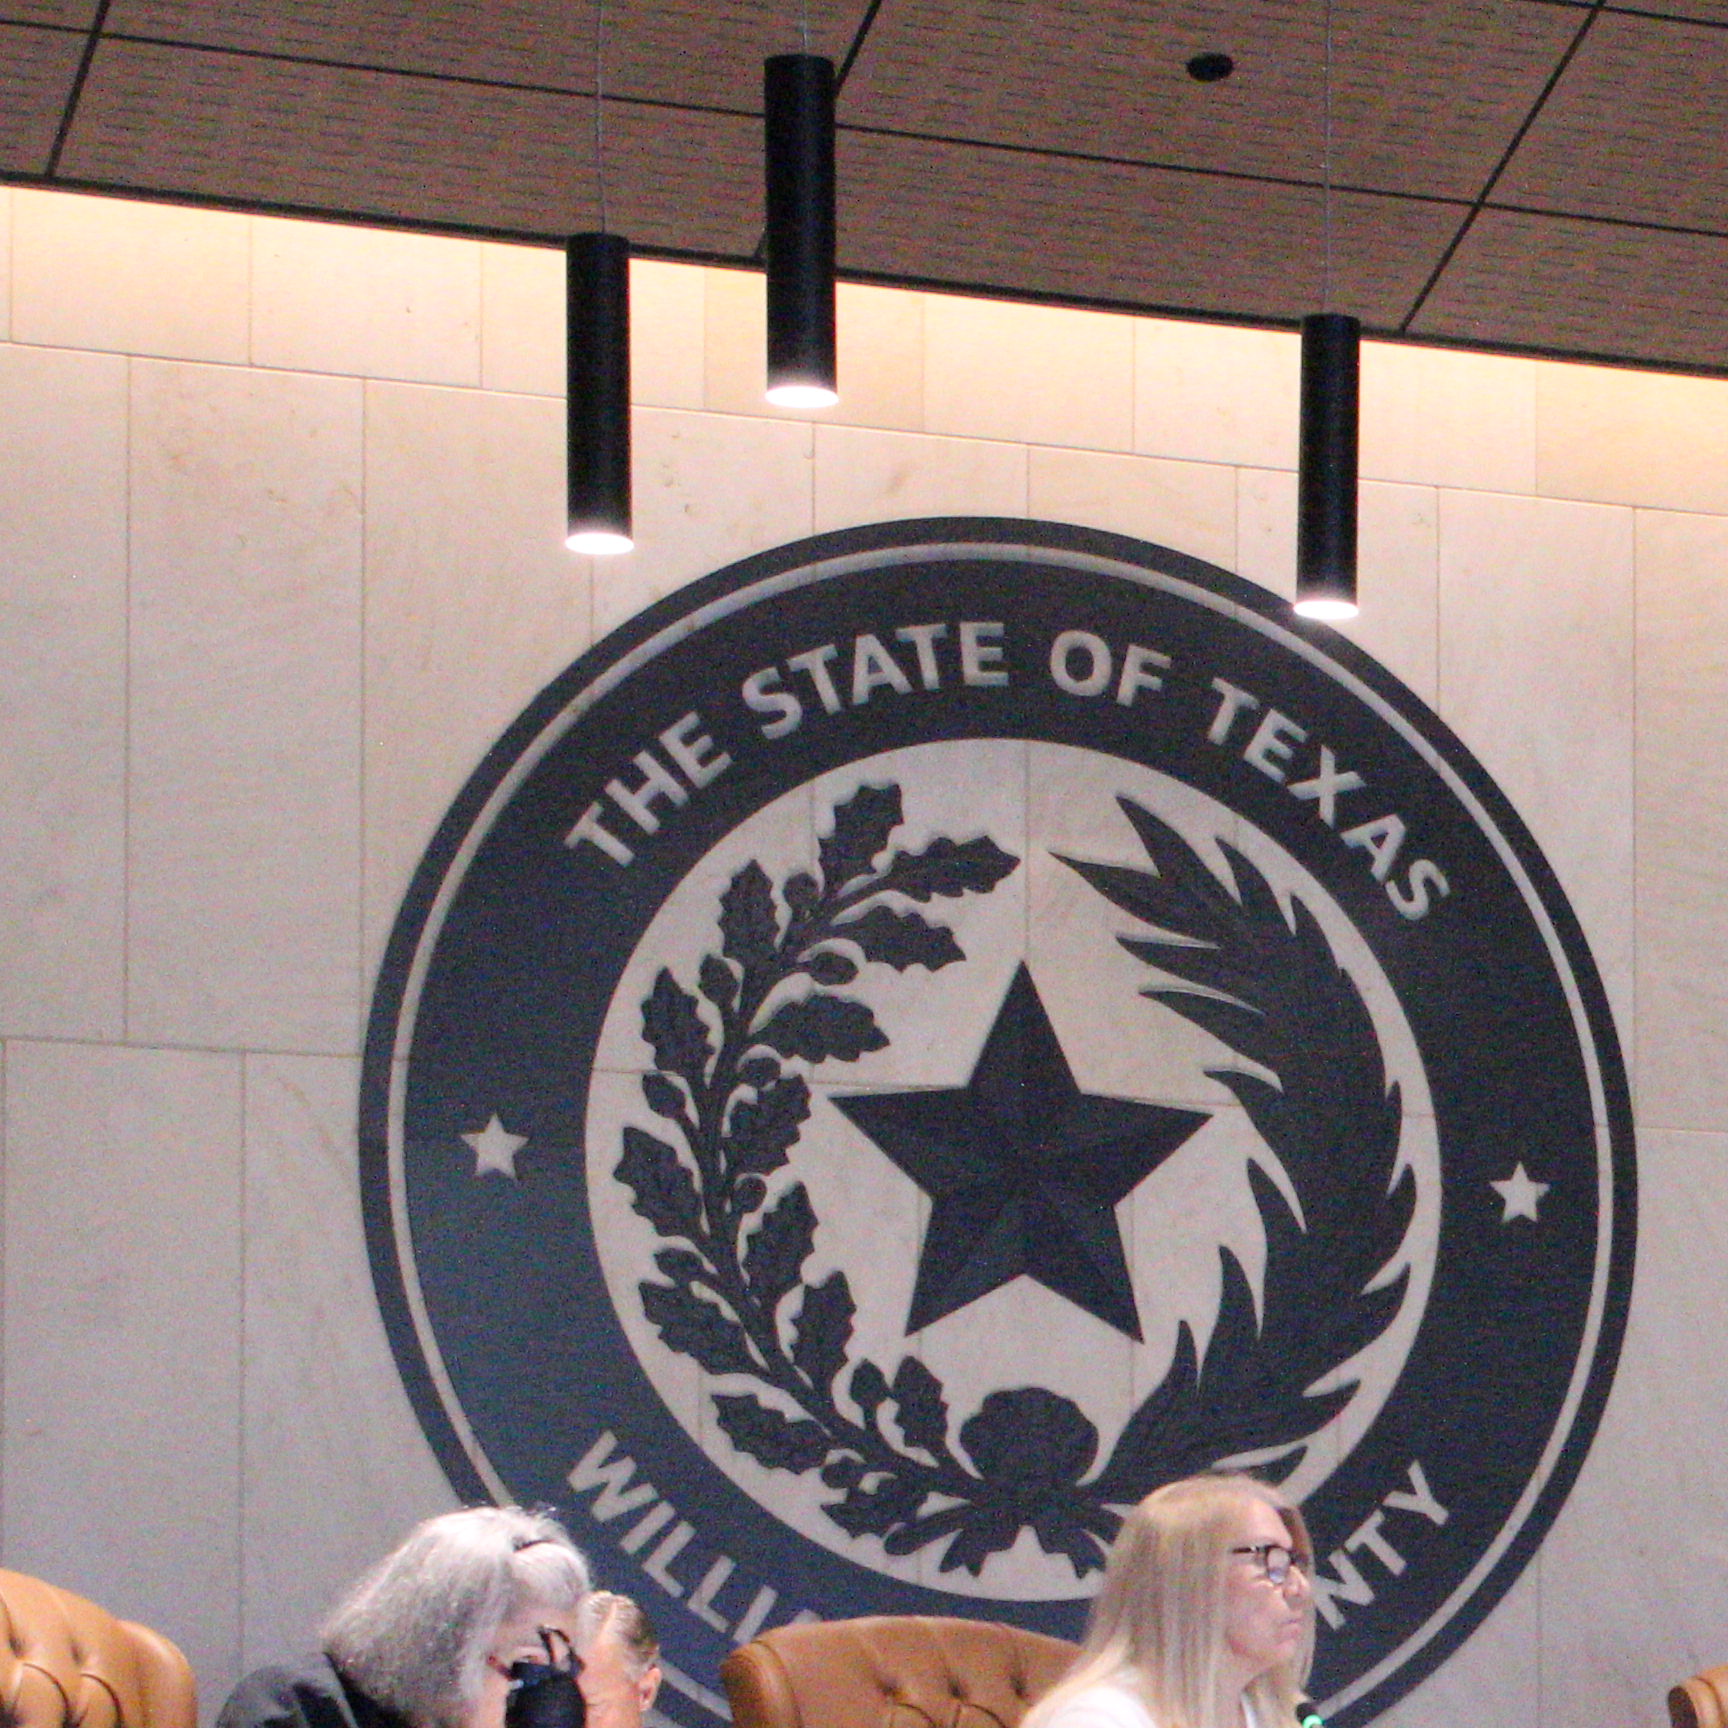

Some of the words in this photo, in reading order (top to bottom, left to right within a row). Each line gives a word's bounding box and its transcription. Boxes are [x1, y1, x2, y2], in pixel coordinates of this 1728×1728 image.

[564, 711, 732, 866] THE
[741, 621, 1009, 739] STATE
[1050, 630, 1172, 706] OF
[1207, 678, 1450, 920] TEXAS
[566, 1430, 822, 1643] WILLI
[1313, 1459, 1448, 1630] NTY
